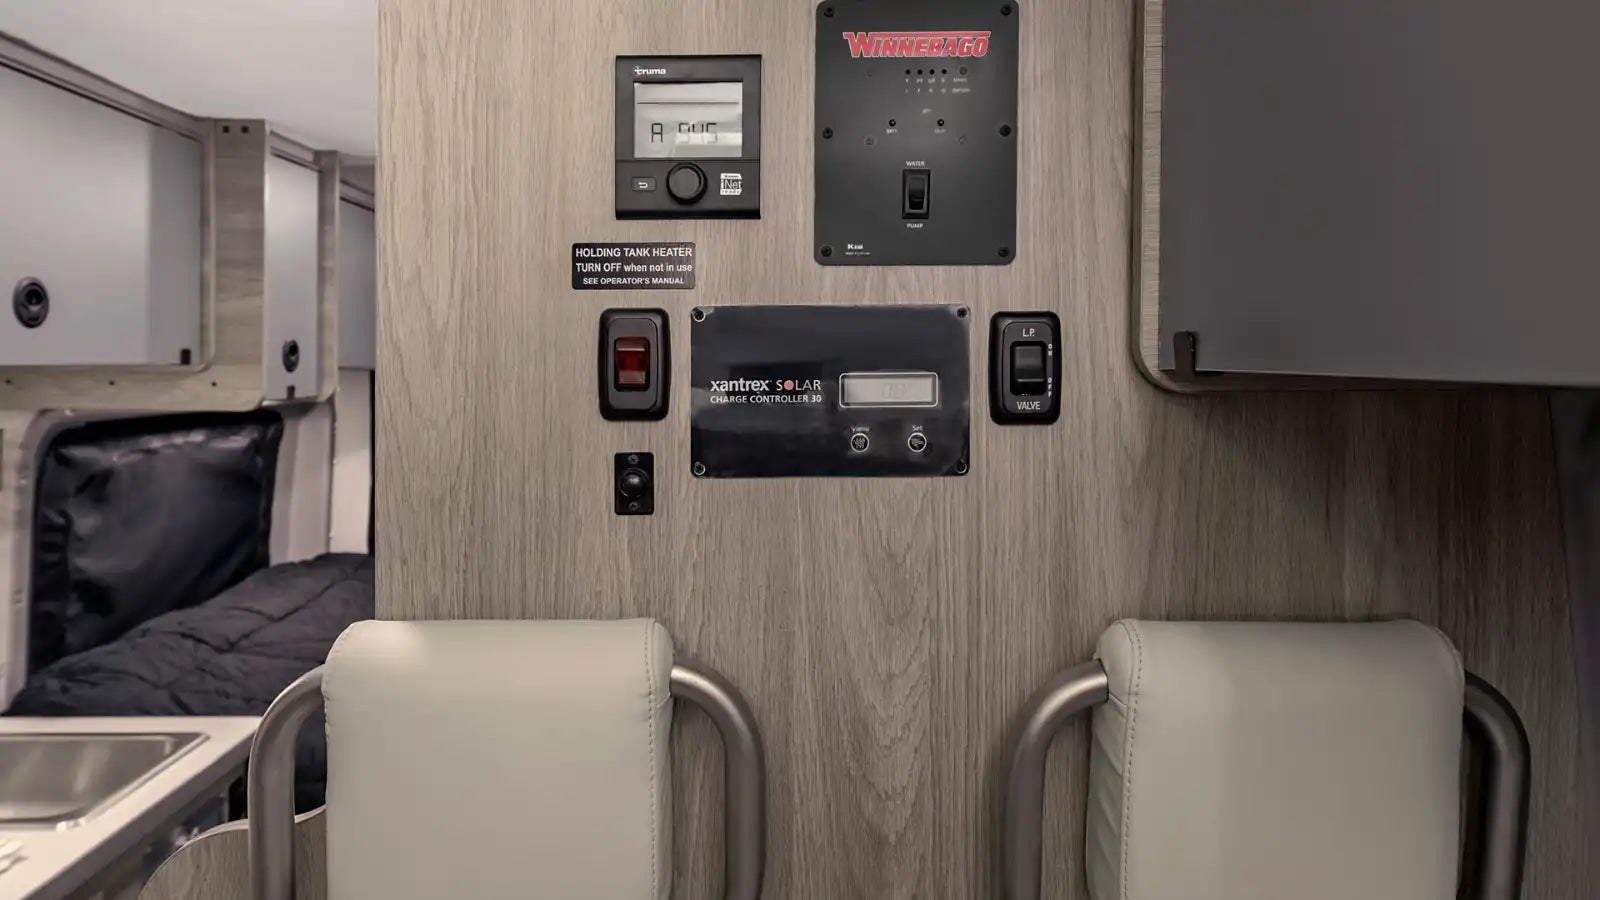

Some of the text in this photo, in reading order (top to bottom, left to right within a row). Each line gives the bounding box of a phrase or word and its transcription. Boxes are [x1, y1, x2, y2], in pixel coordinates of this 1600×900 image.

[843, 31, 991, 58] WINNEBAGO
[634, 67, 667, 75] truma
[575, 247, 693, 258] HOLDING TANK HEATER
[576, 262, 693, 273] TURN OFF when not in use
[582, 277, 684, 285] SEE OPERATOR'S MANUAL
[710, 378, 822, 392] xantrex SOLAR
[710, 394, 822, 404] CHARGE CONTROLLER 30
[1016, 401, 1041, 410] VALVE
